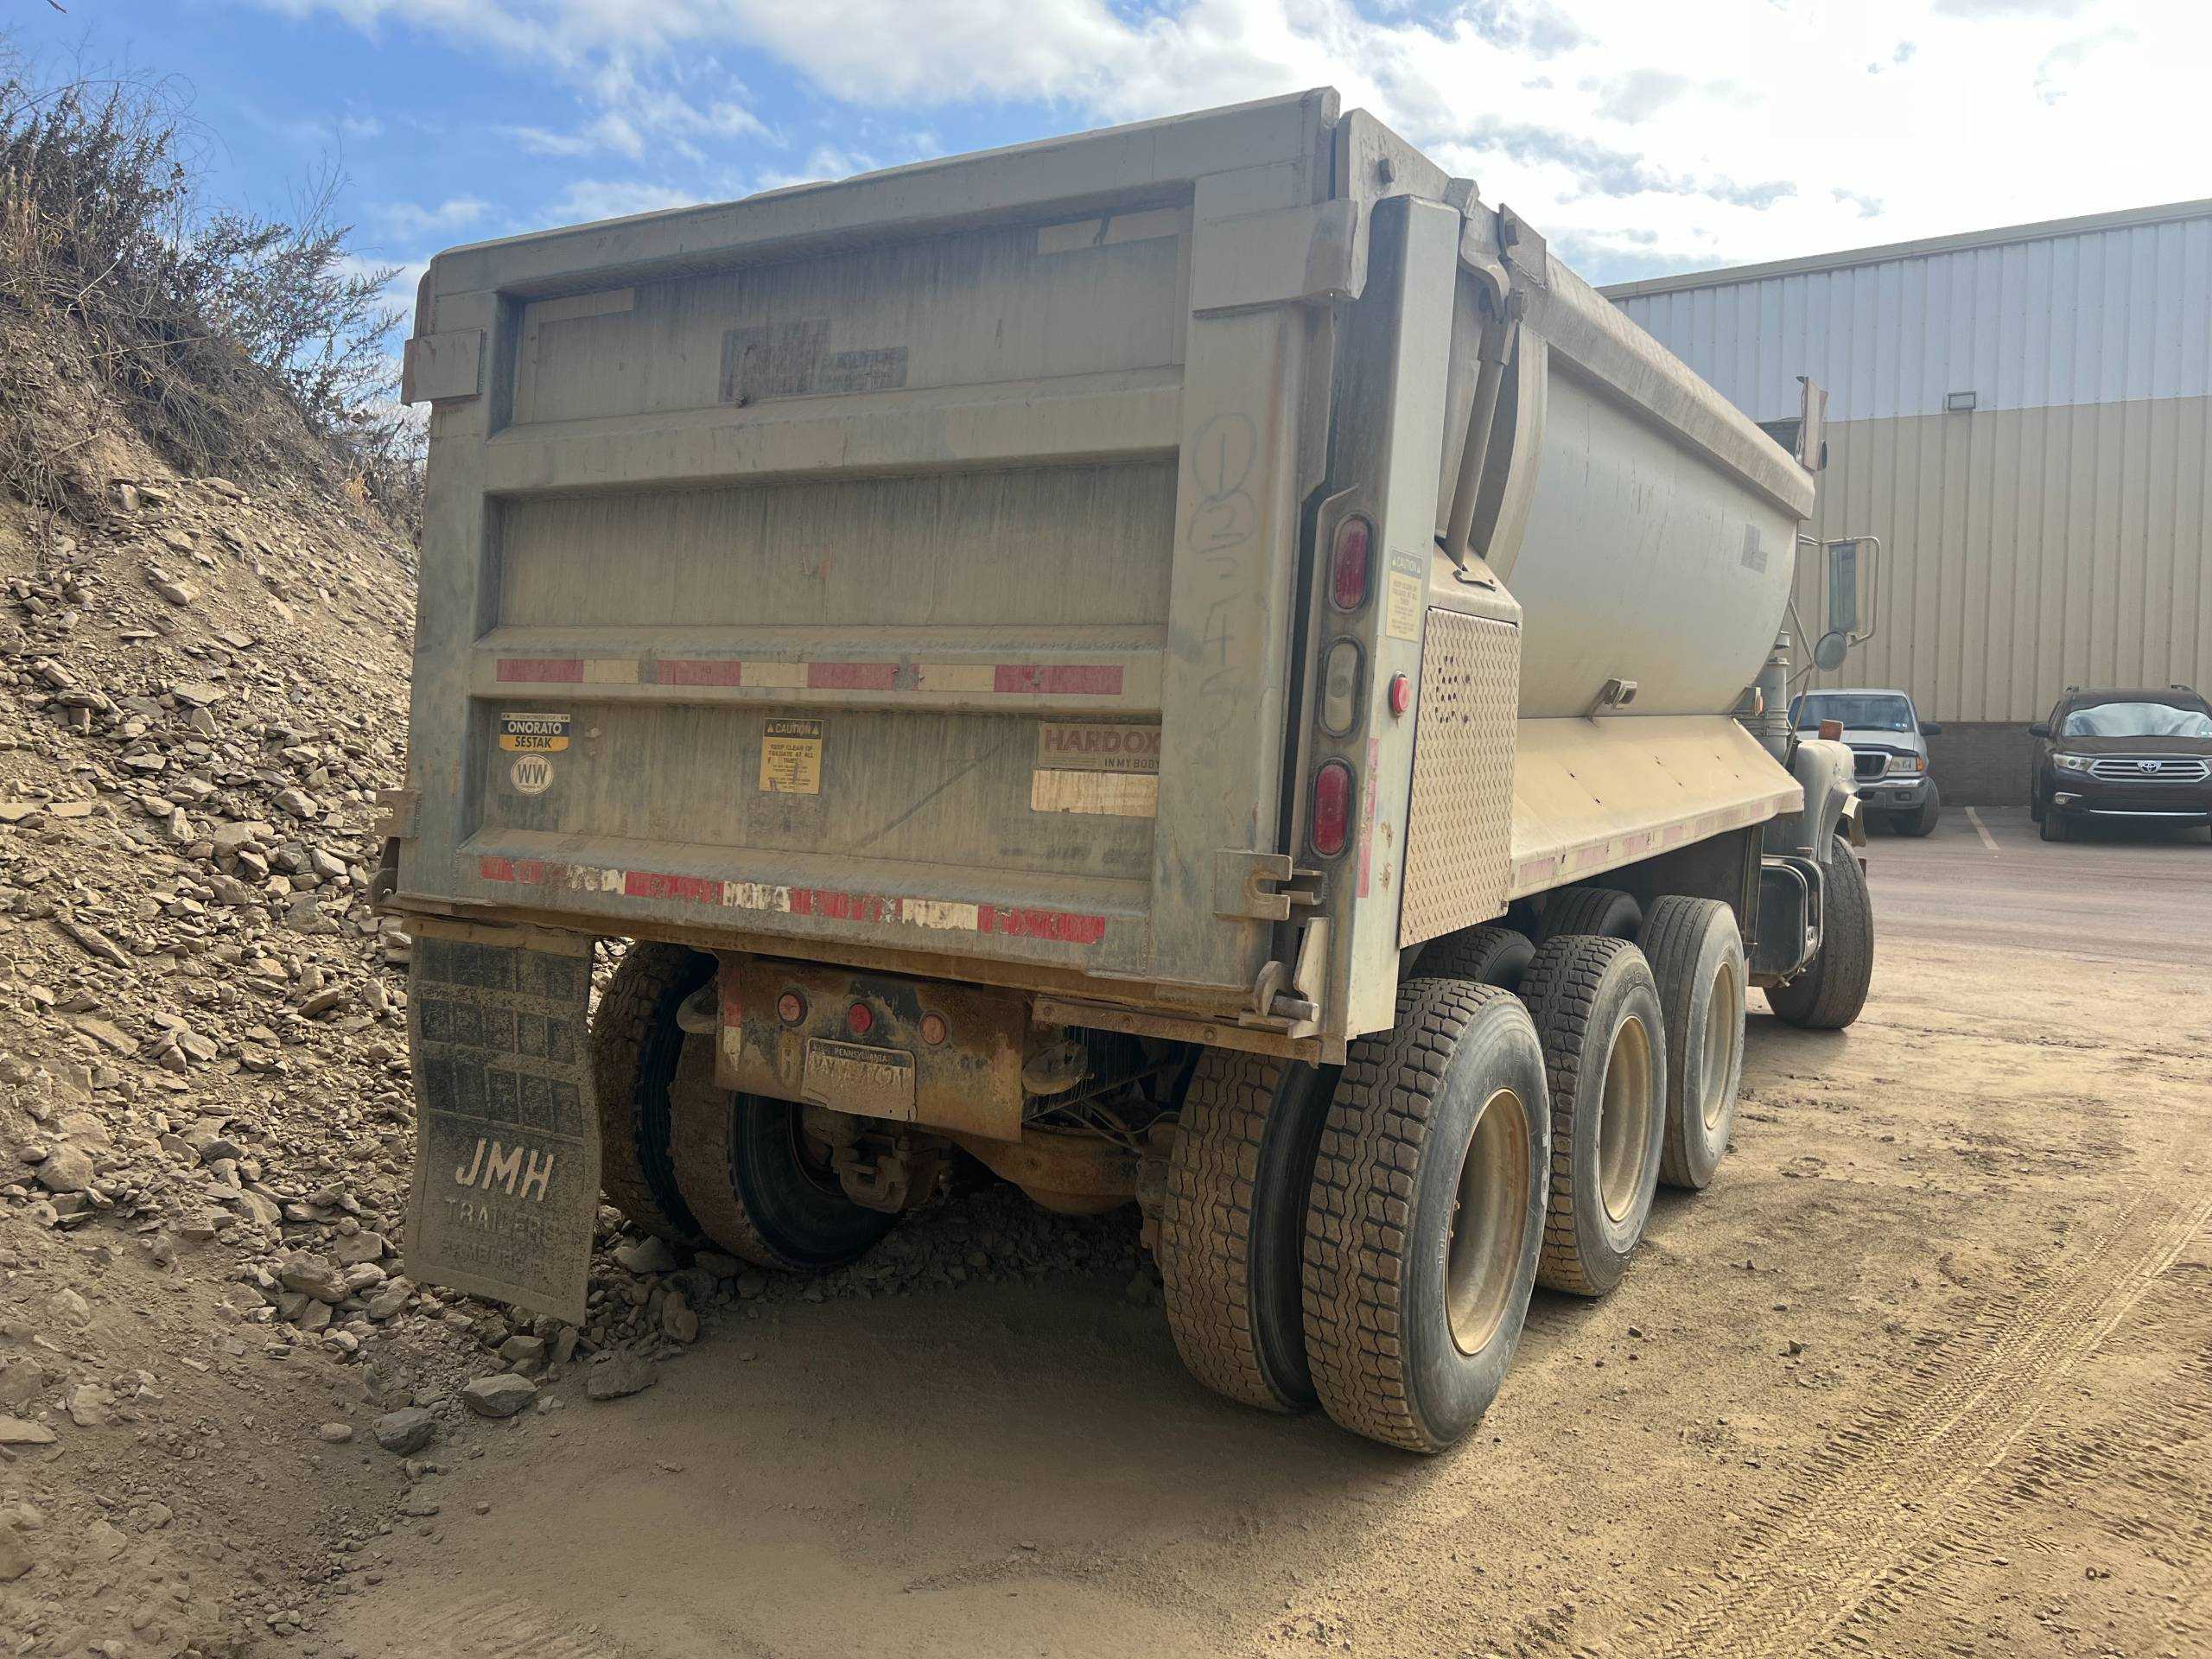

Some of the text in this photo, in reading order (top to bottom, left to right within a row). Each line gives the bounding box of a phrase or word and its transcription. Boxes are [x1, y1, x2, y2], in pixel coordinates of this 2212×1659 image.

[507, 721, 563, 734] ONORATO
[775, 722, 810, 734] CAUTION
[514, 735, 553, 748] SESTAK
[1044, 729, 1161, 753] HARDOX
[1105, 758, 1115, 766] IN
[1117, 758, 1131, 767] MY
[518, 764, 548, 784] WW
[834, 1047, 888, 1063] PENNSYLVANIA
[454, 1137, 554, 1201] JMH
